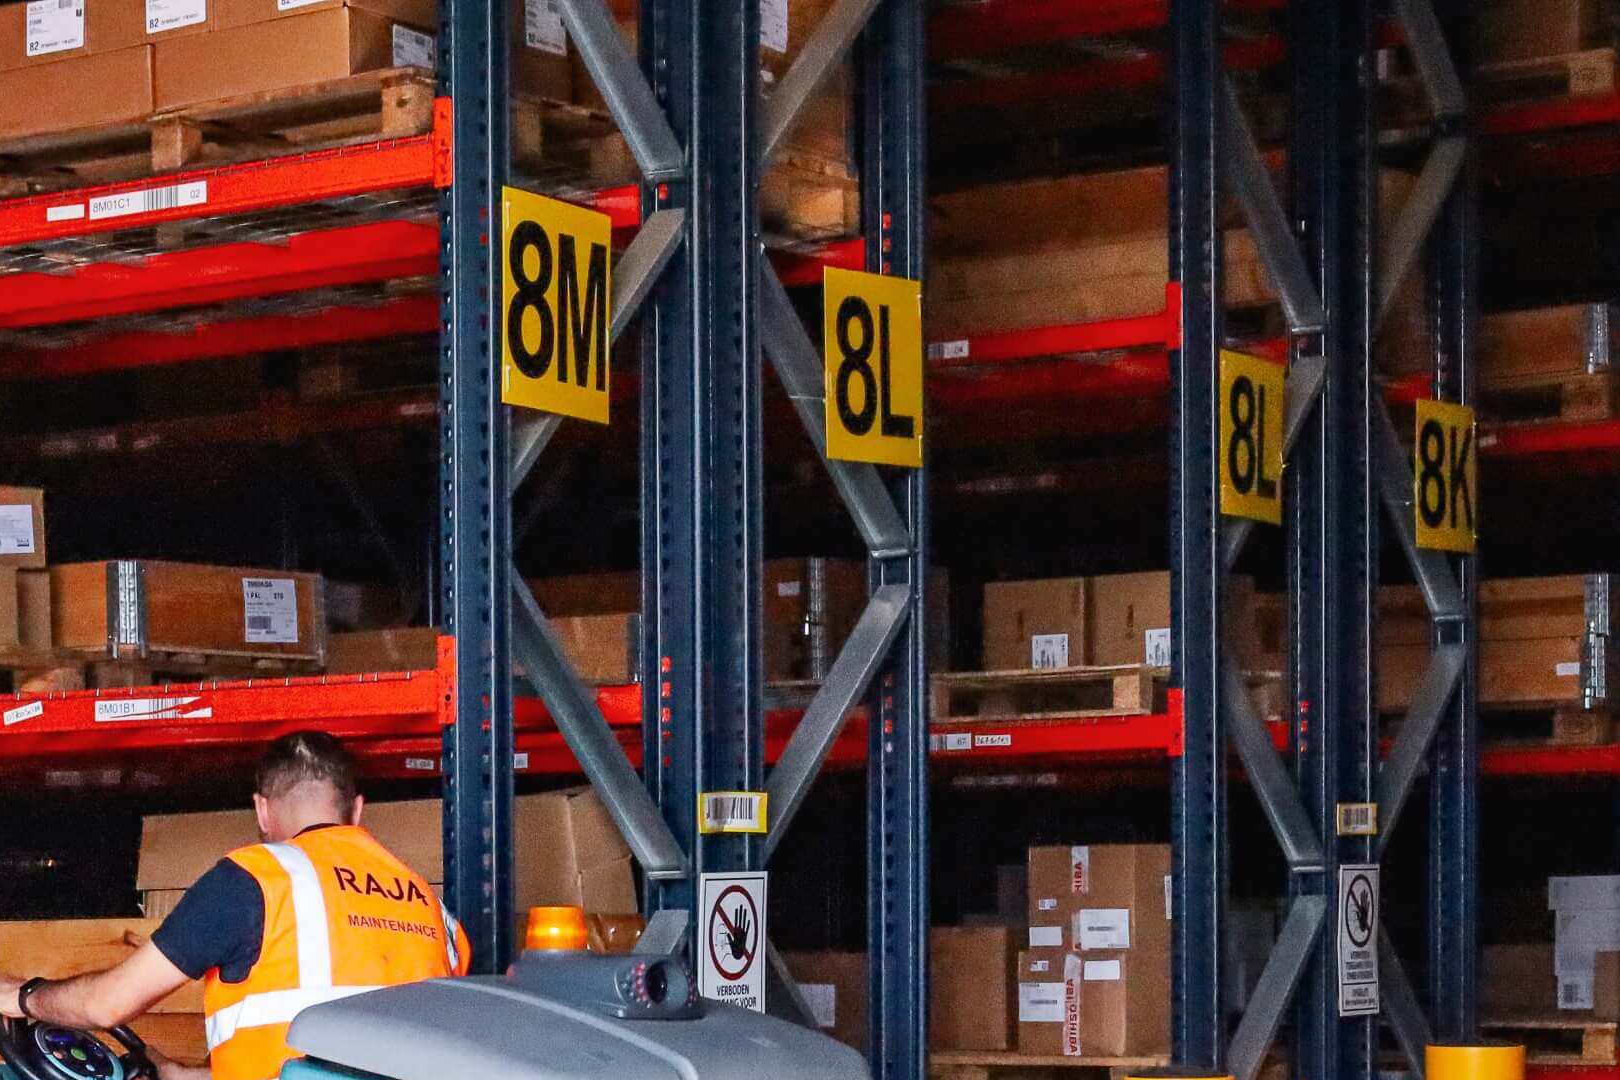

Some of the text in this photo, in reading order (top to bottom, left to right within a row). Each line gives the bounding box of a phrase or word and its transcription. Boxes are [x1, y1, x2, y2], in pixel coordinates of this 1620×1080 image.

[92, 198, 131, 213] 8M01C1
[508, 219, 607, 393] 8M
[836, 295, 915, 438] 8L
[1228, 375, 1278, 500] 8L
[1419, 419, 1473, 531] 8K
[97, 703, 136, 715] 8M01B1
[333, 866, 429, 906] RAJA
[347, 914, 438, 939] MAINTENANCE
[716, 984, 749, 996] VERBODEN
